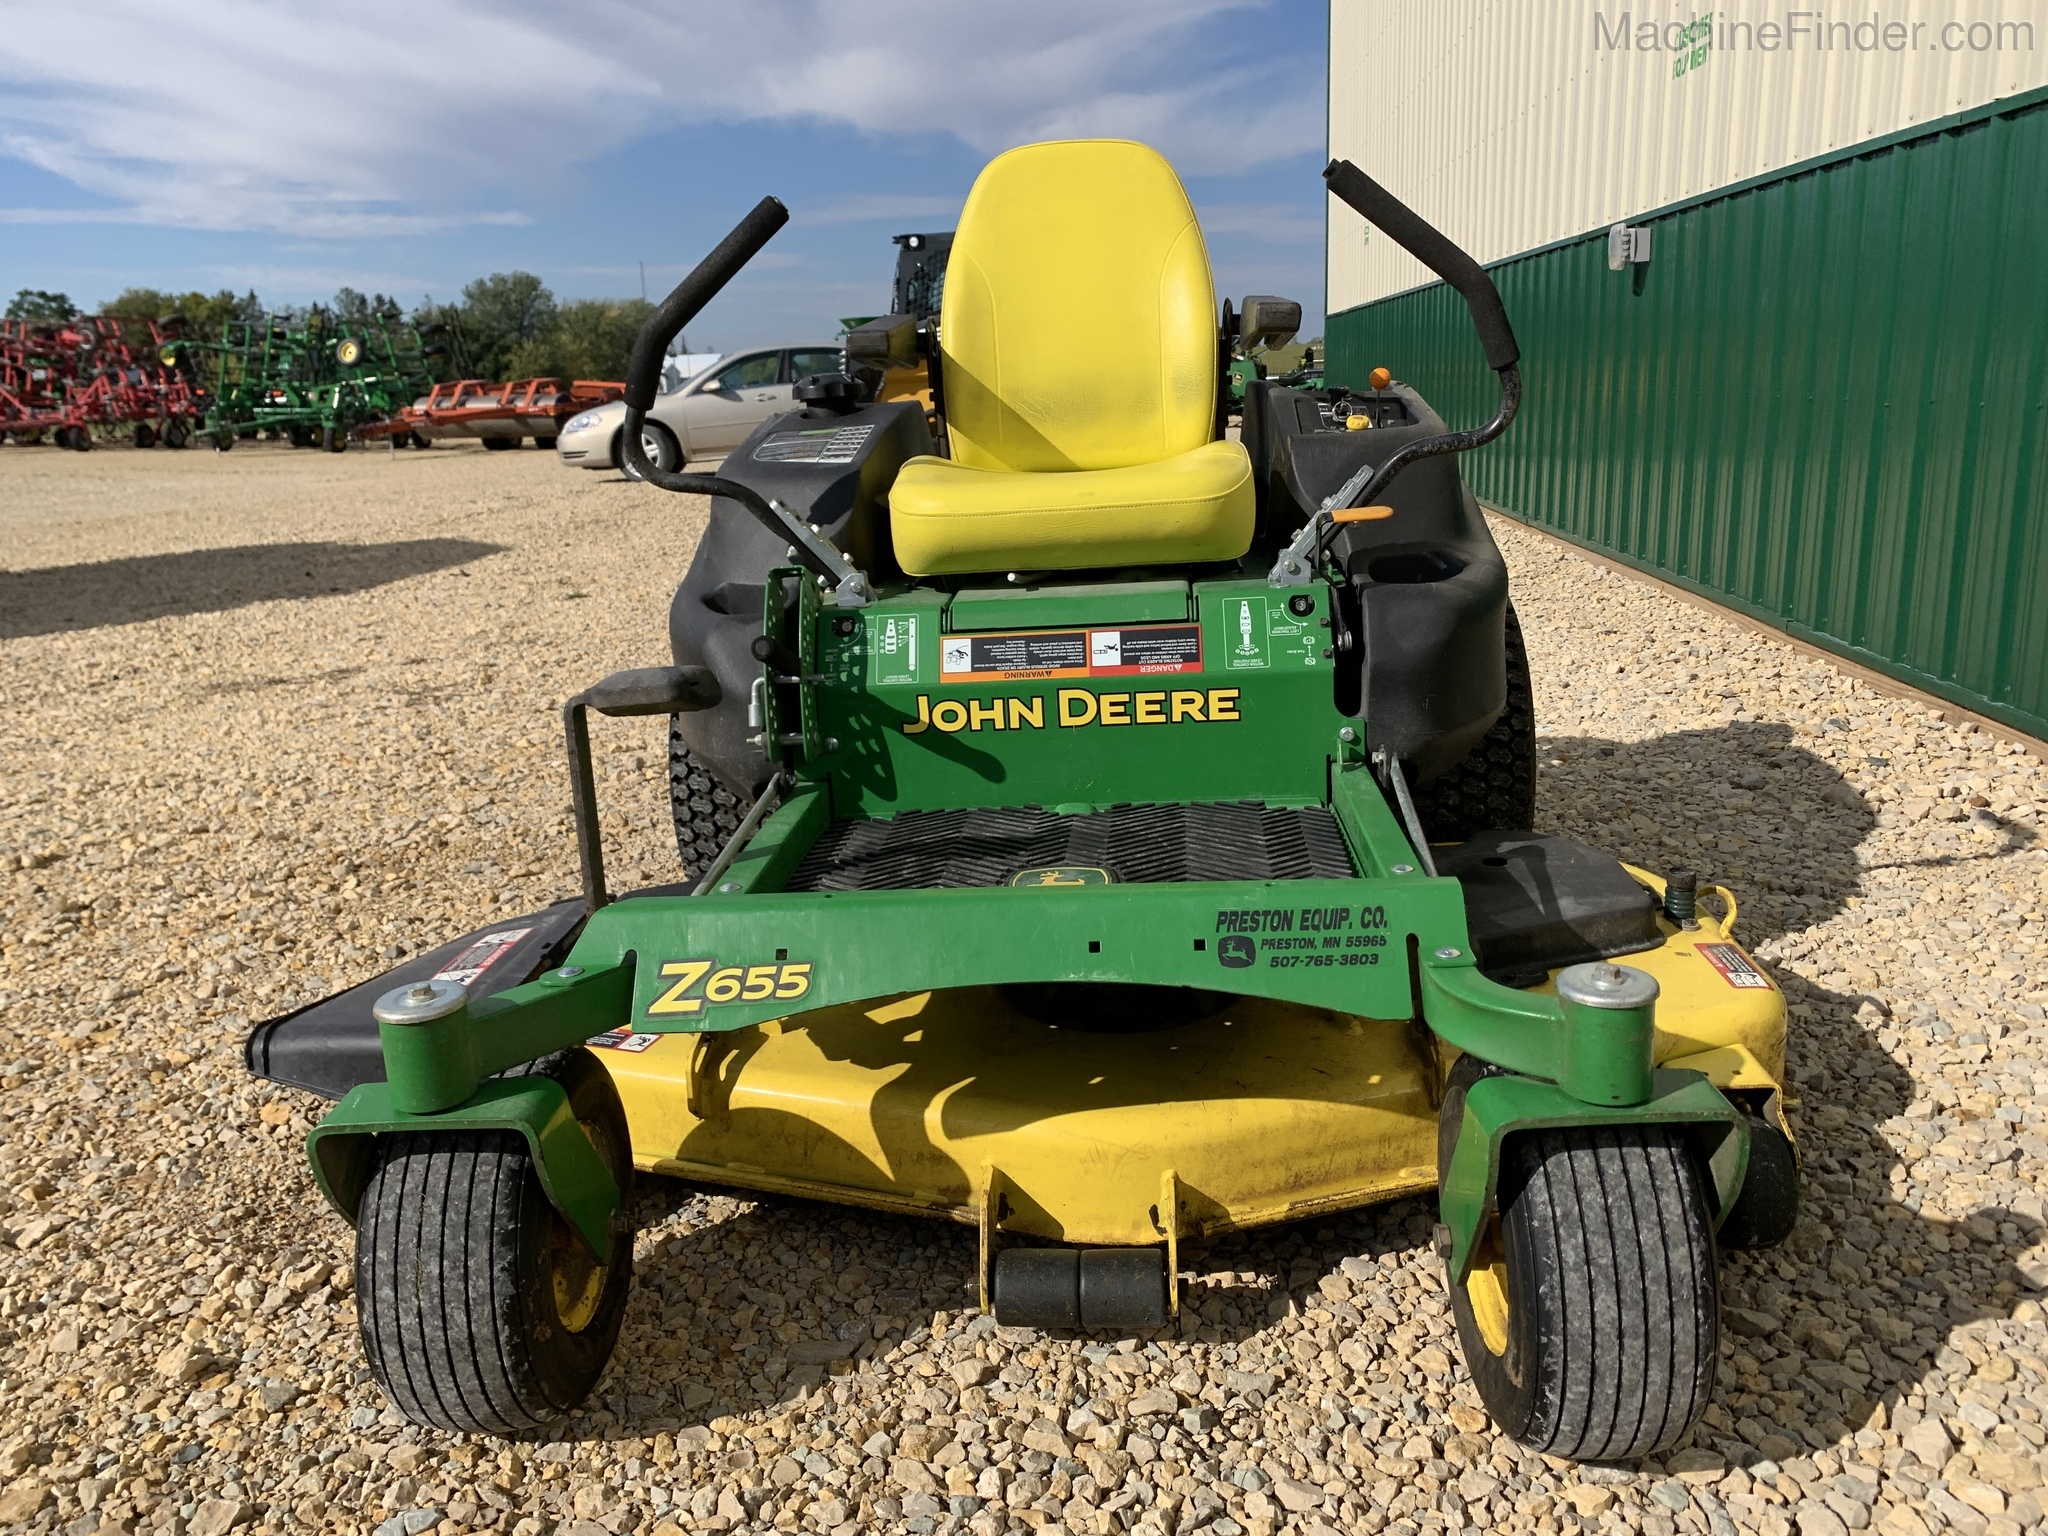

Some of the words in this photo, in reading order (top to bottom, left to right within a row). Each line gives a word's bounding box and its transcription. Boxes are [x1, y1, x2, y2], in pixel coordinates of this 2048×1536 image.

[1004, 671, 1044, 679] WARNING
[903, 694, 1044, 734] JOHN
[1057, 687, 1241, 728] DEERE
[1216, 910, 1294, 933] PRESTON
[1300, 908, 1352, 933] EQUIP.
[1360, 906, 1388, 929] CO.
[1260, 938, 1318, 950] PRESTON,
[1322, 937, 1341, 948] MN
[1346, 936, 1387, 948] 55965
[1270, 954, 1379, 968] 507-765-3803
[646, 959, 814, 1016] Z655
